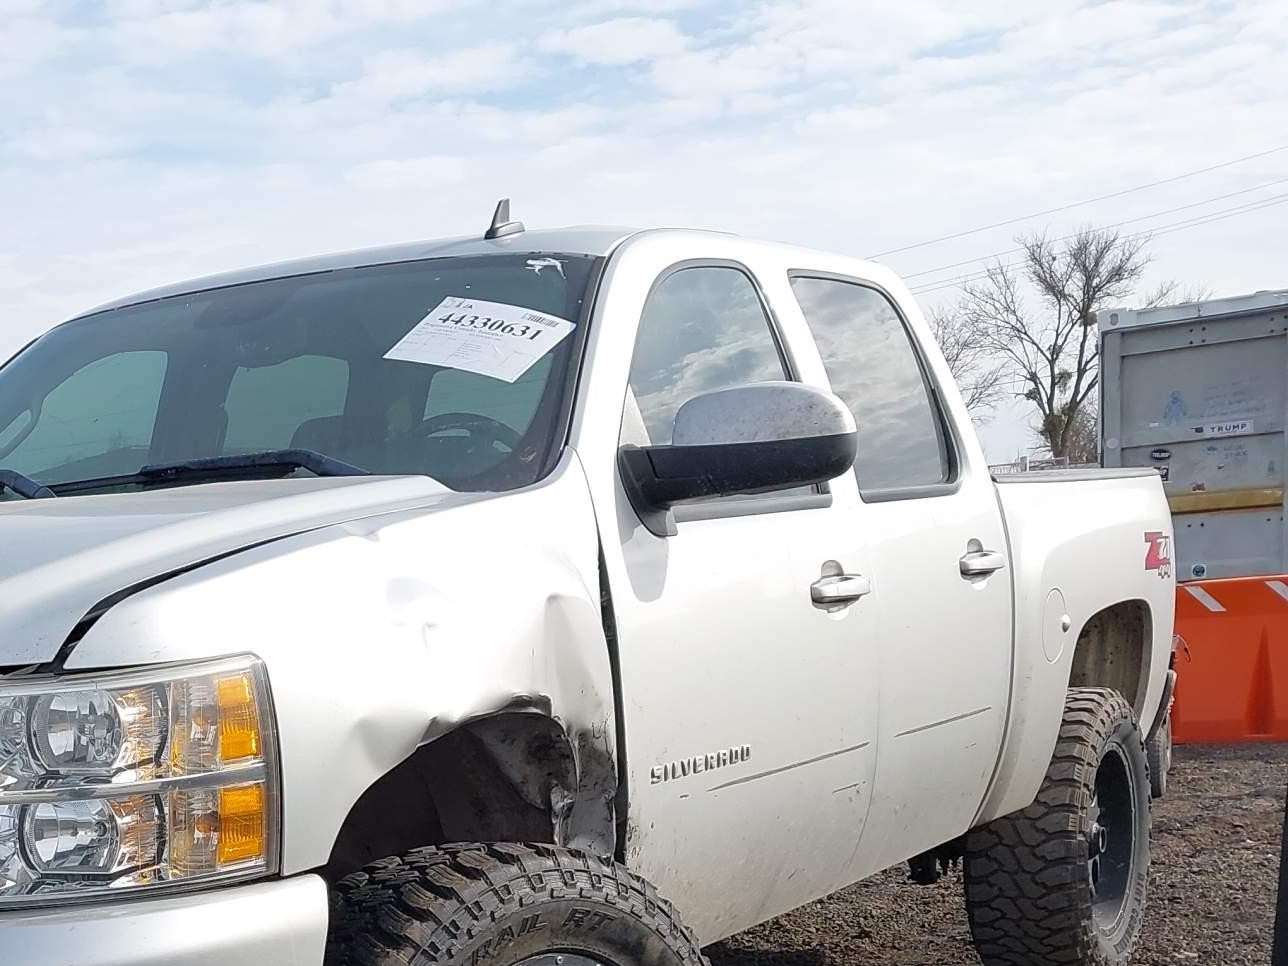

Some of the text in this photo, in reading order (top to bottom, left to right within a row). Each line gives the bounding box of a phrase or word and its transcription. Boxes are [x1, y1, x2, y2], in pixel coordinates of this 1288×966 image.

[438, 312, 544, 340] 44330631
[1210, 423, 1247, 433] TRUMP
[650, 744, 752, 785] SILVERADO
[560, 906, 617, 931] RT
